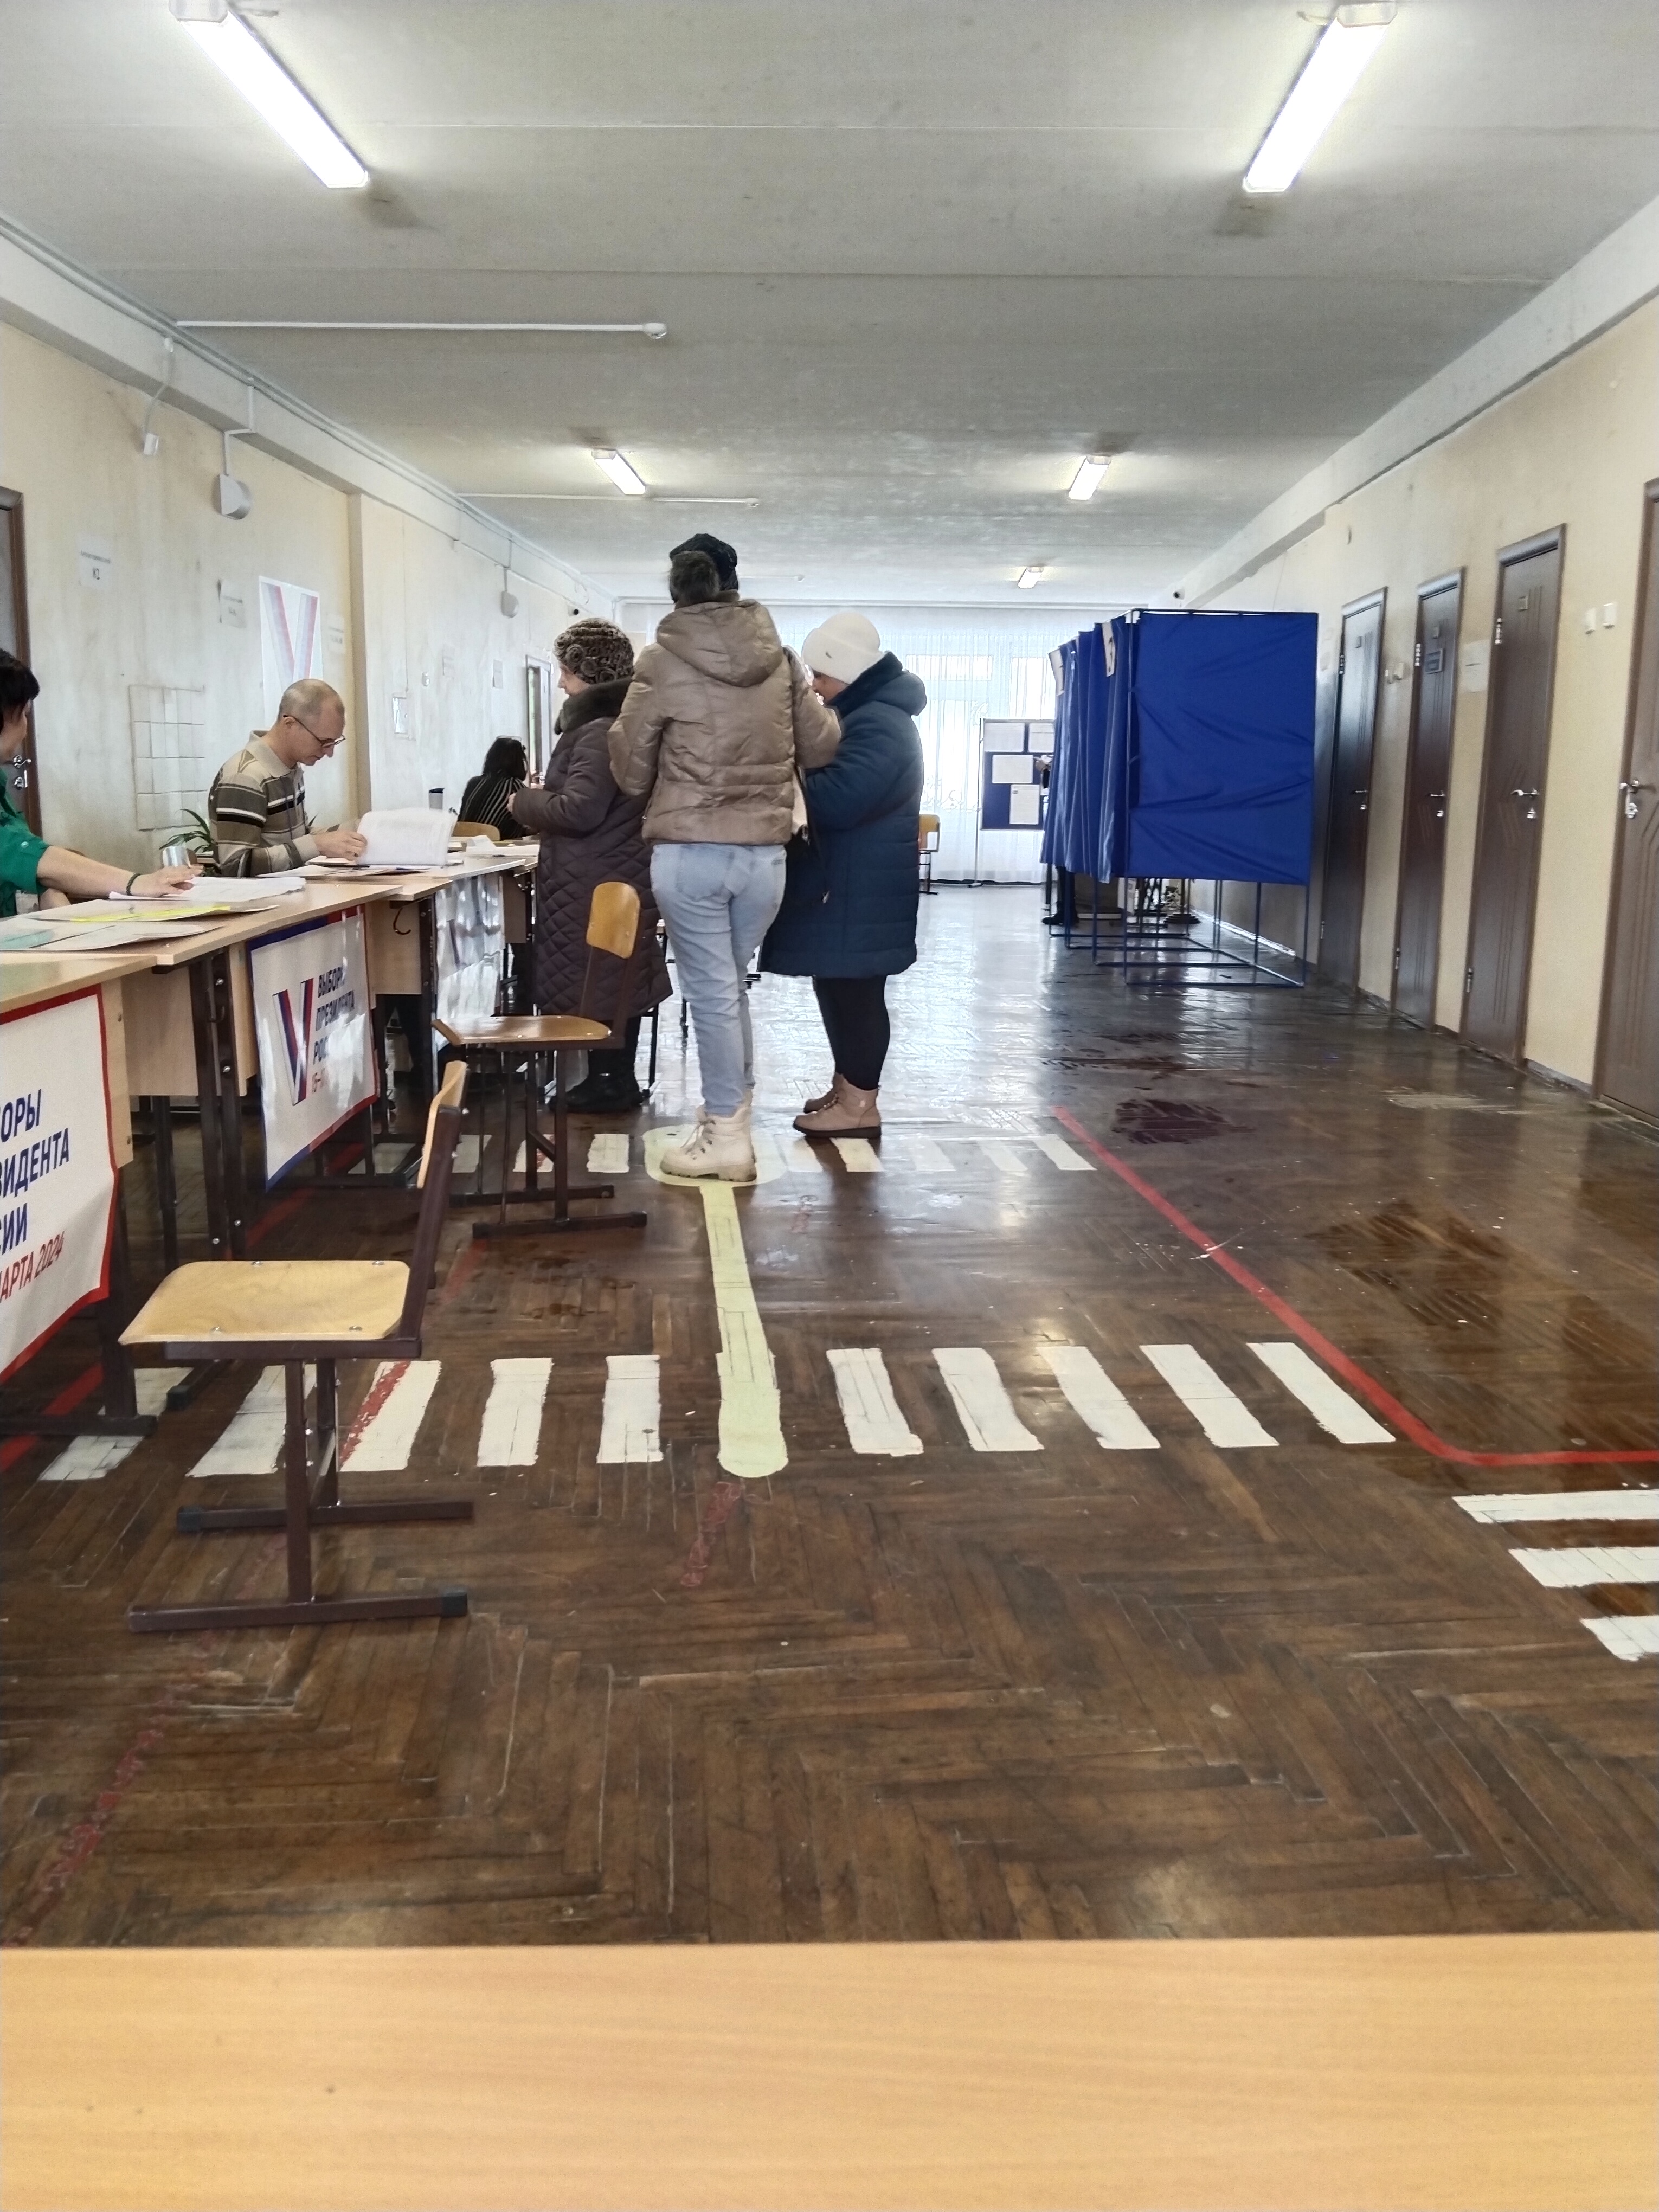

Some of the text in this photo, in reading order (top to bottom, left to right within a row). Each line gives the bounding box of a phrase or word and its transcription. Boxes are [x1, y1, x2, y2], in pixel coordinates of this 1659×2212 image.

[0, 1089, 42, 1142] ОРЫ
[0, 1128, 69, 1198] ИДЕНТА
[0, 1203, 27, 1255] ИИ
[0, 1230, 65, 1302] АРТА 2024
